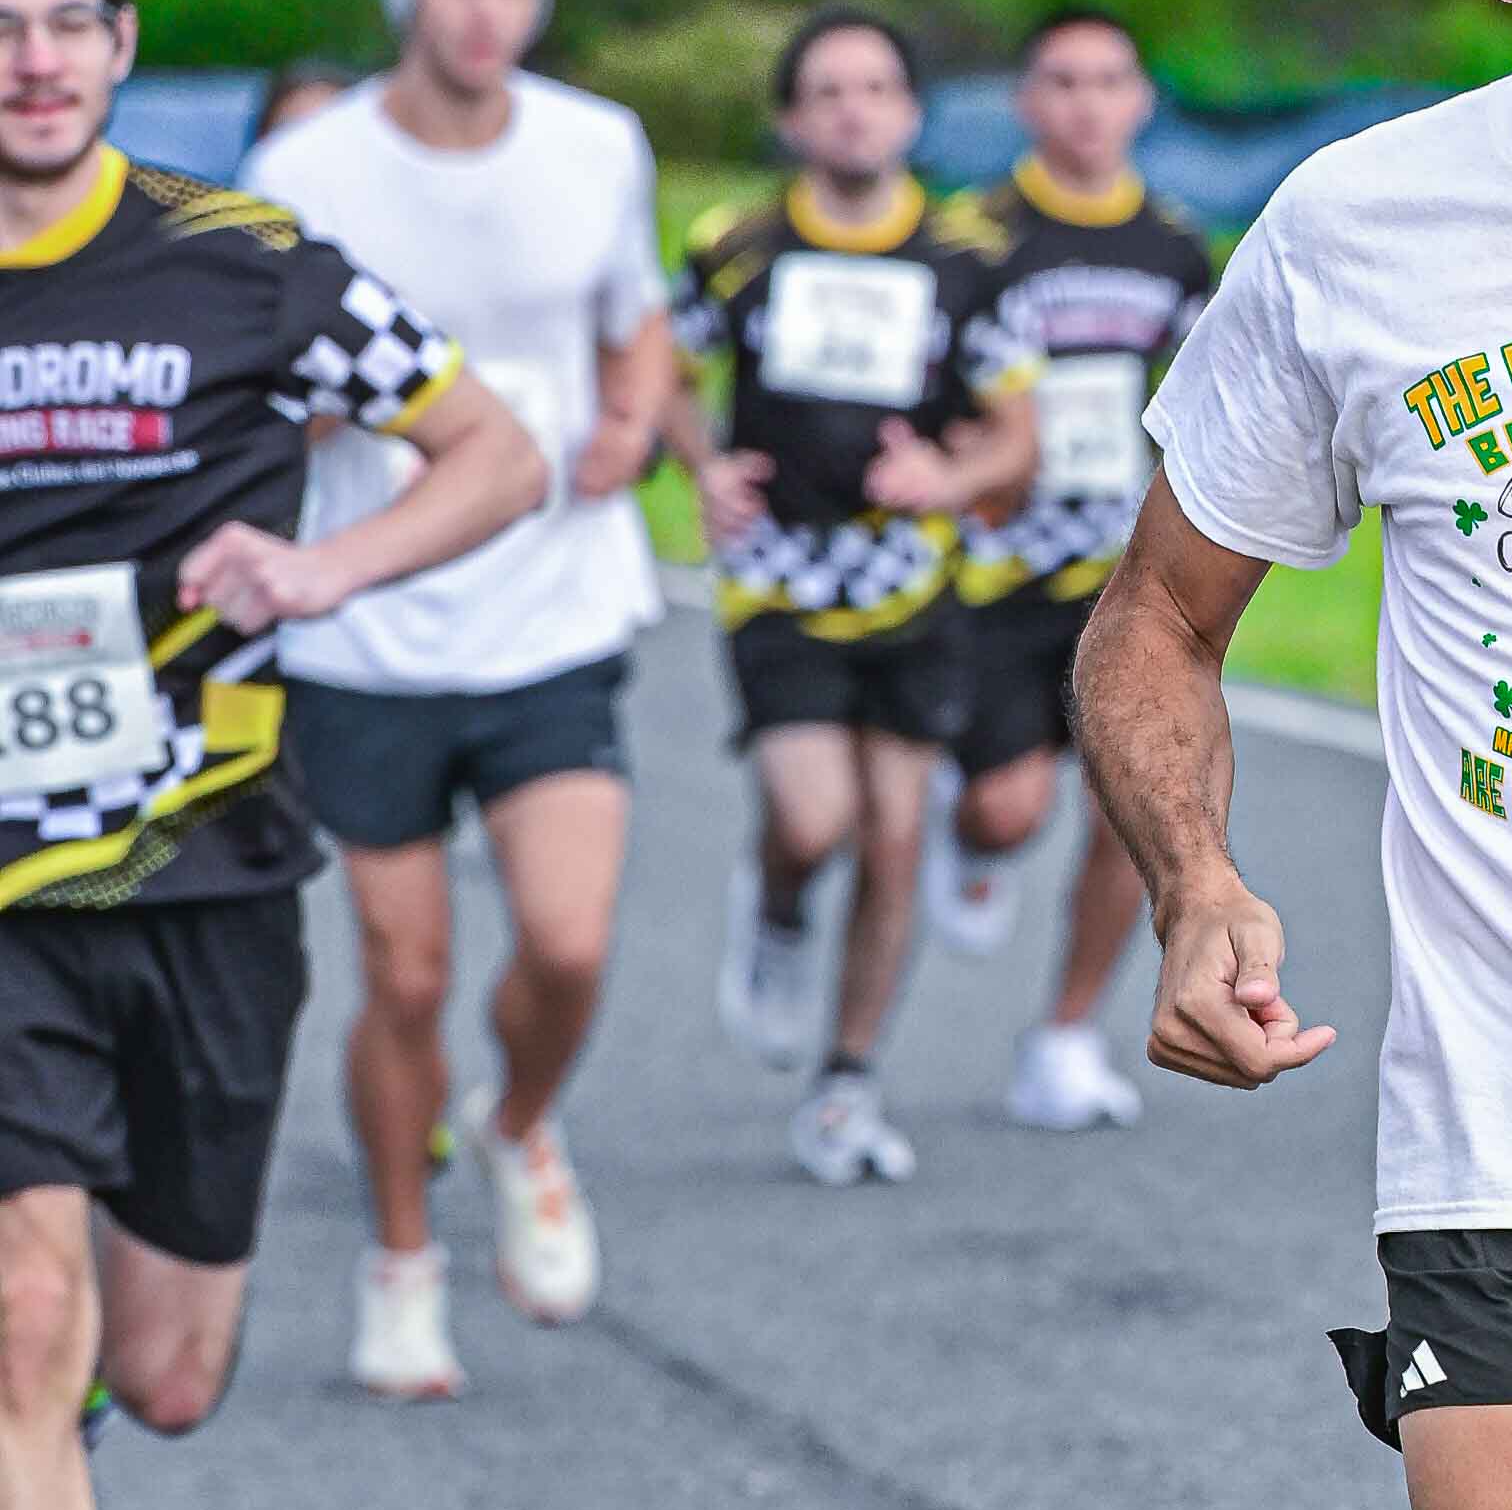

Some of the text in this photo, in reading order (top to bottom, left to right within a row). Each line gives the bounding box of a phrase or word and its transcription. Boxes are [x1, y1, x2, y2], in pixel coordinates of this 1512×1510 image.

[1405, 353, 1501, 450] THE
[0, 677, 114, 757] 88
[1459, 747, 1507, 820] ARE
